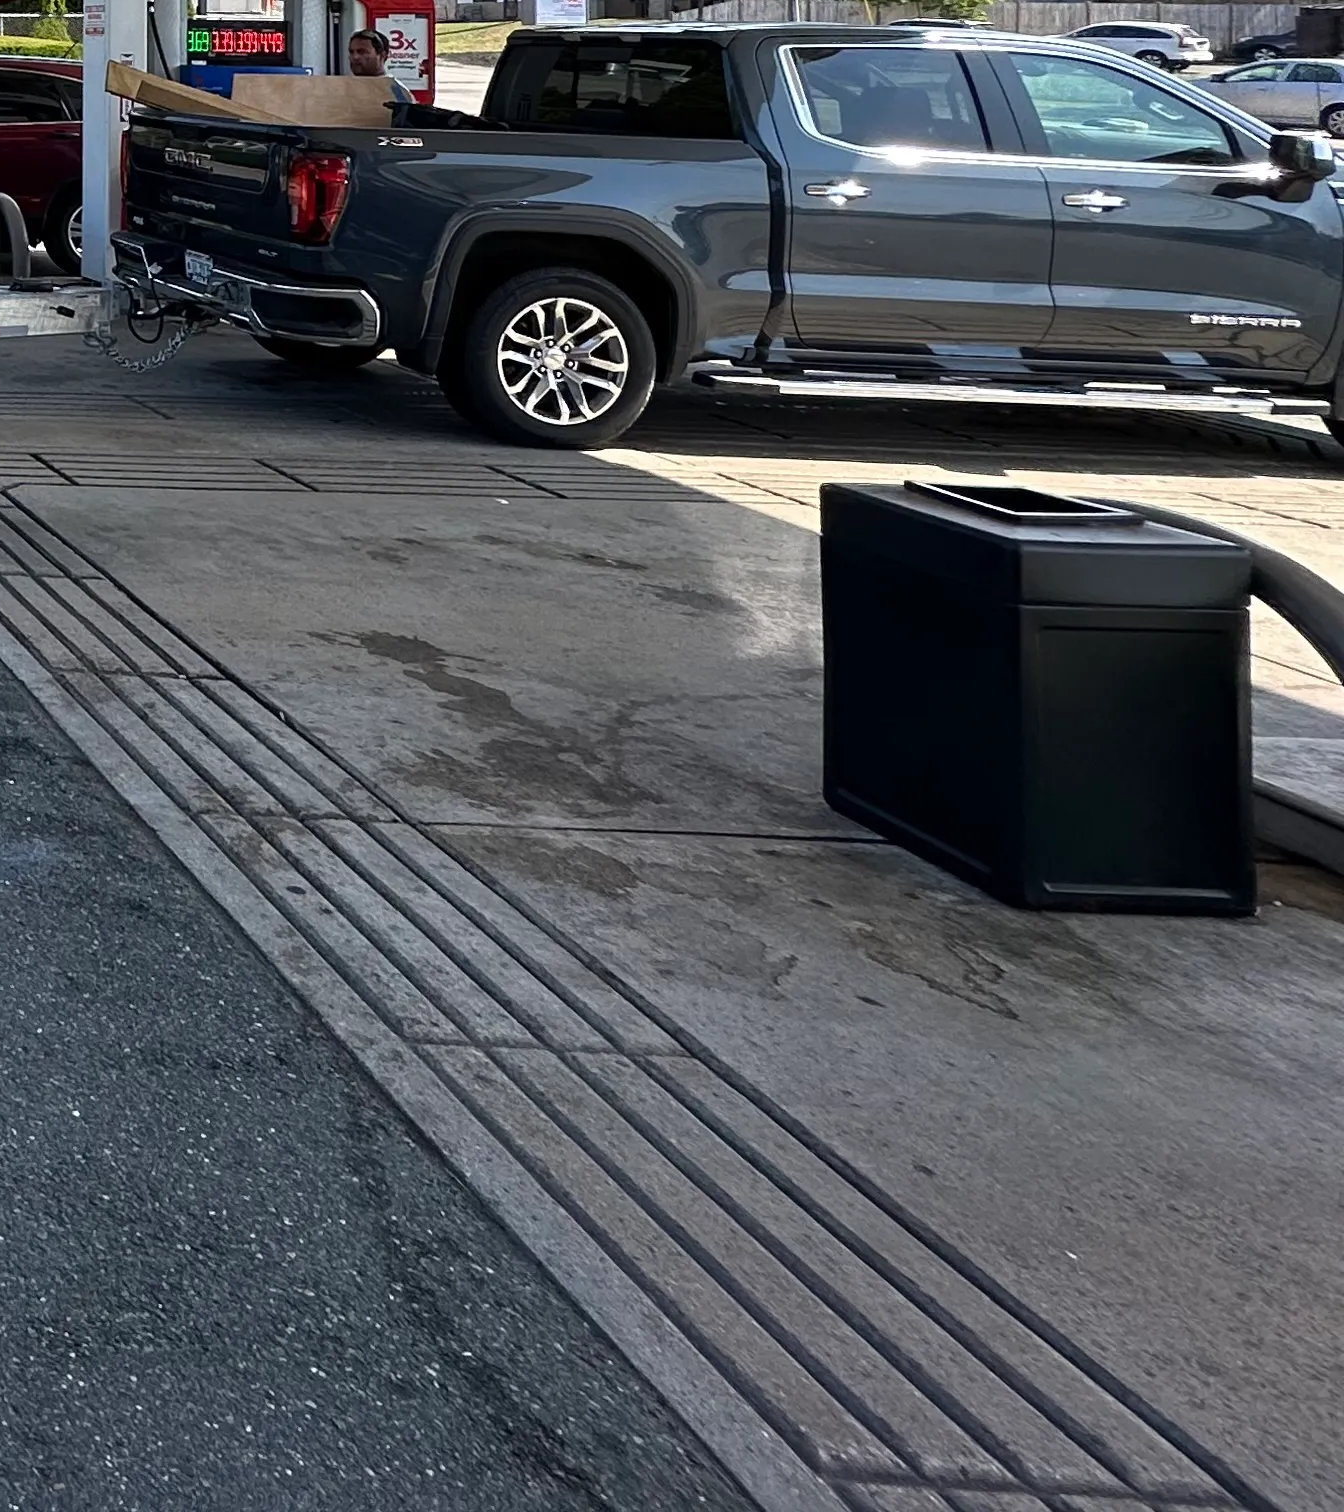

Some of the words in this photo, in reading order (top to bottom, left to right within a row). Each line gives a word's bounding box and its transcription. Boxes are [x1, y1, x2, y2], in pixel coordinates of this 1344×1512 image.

[389, 29, 417, 51] 3x
[388, 50, 420, 59] leaner
[164, 147, 212, 169] GMC
